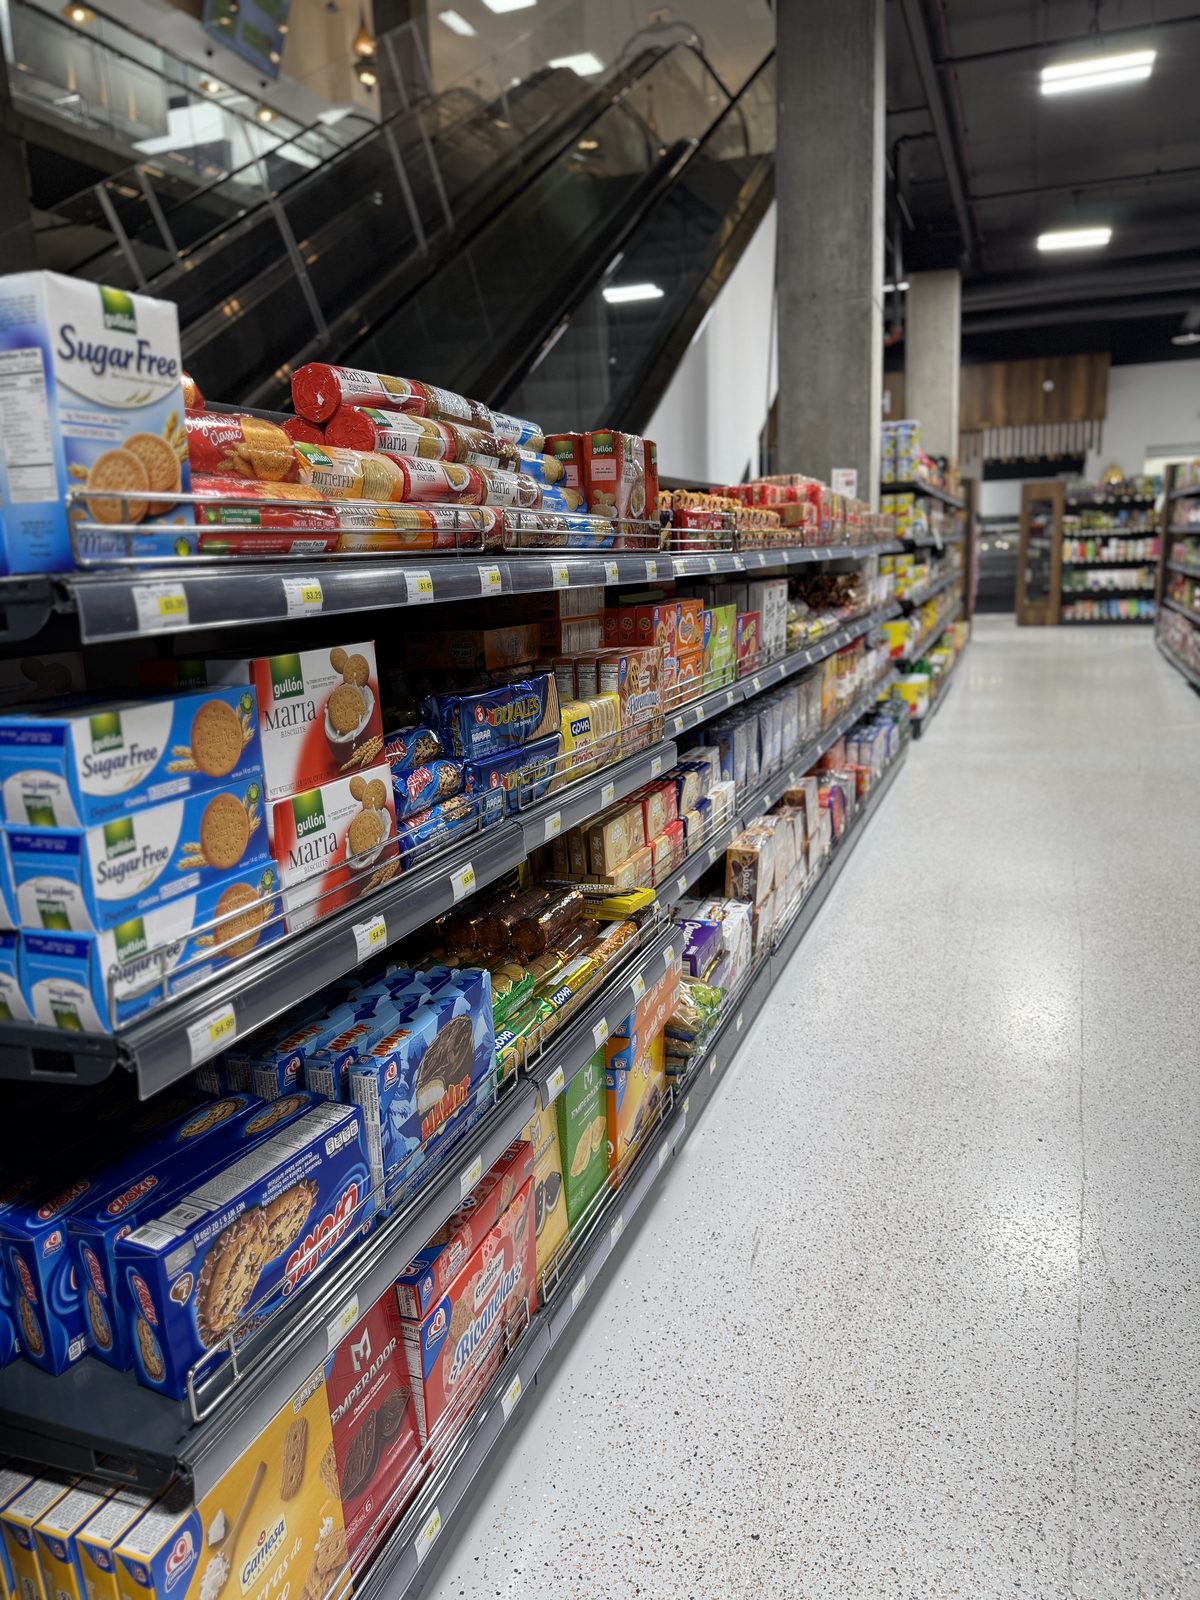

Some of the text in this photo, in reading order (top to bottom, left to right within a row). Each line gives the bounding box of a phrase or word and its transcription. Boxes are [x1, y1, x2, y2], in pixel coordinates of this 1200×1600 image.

[210, 428, 243, 447] Classic
[593, 444, 613, 455] gullón
[272, 677, 303, 699] gullón
[263, 700, 318, 733] Maria
[280, 726, 307, 739] BISCUITS
[571, 720, 590, 735] GOYA
[297, 812, 326, 837] gullón
[288, 831, 339, 871] Maria
[304, 857, 330, 874] BISCUITS
[372, 927, 386, 941] $4.99
[553, 985, 573, 1006] GOYA
[215, 1019, 235, 1036] $4.99
[225, 1208, 238, 1220] WT
[233, 1201, 247, 1213] NET
[476, 1257, 503, 1298] Gamesa
[331, 1337, 396, 1425] EMPERADOR
[242, 1519, 285, 1585] Gamesa
